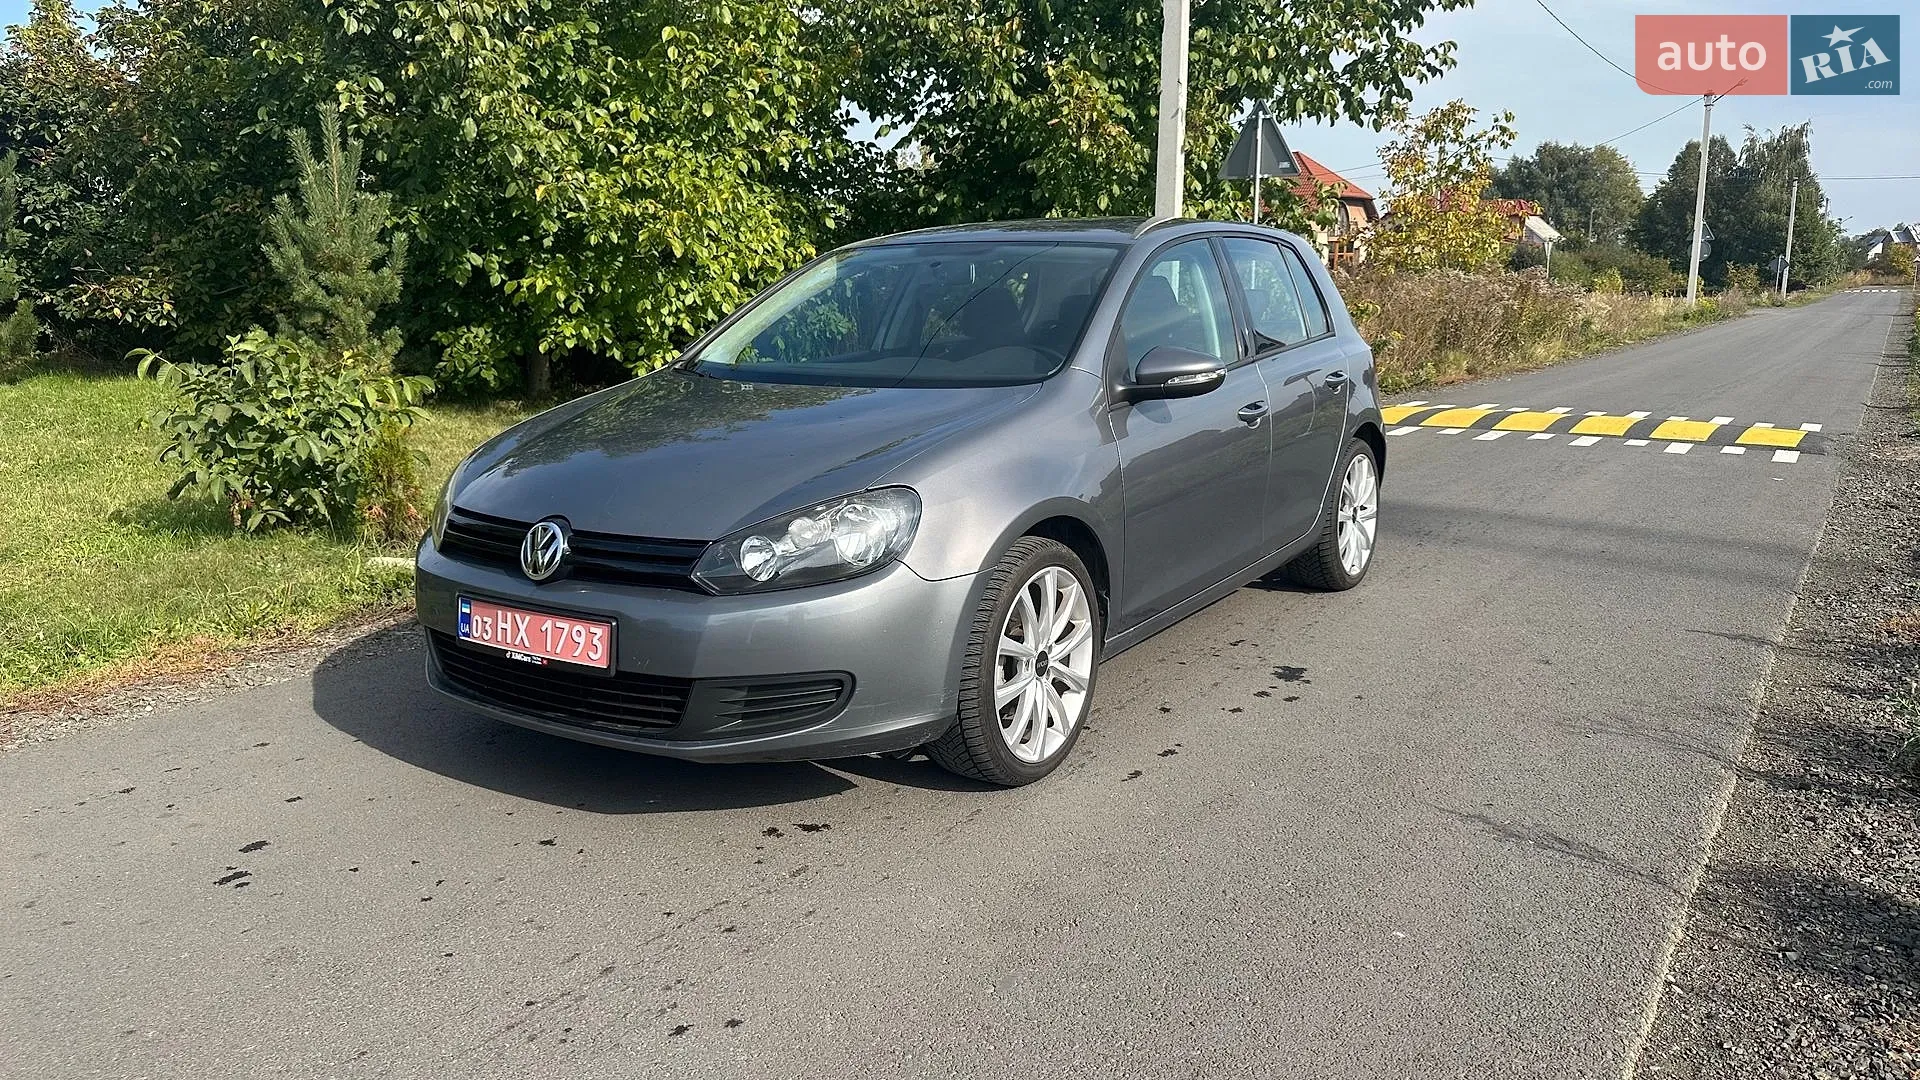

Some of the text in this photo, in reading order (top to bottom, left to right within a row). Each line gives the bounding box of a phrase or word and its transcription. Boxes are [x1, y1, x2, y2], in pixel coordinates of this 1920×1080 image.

[460, 622, 470, 634] UA
[472, 610, 603, 661] 03 HX 1793
